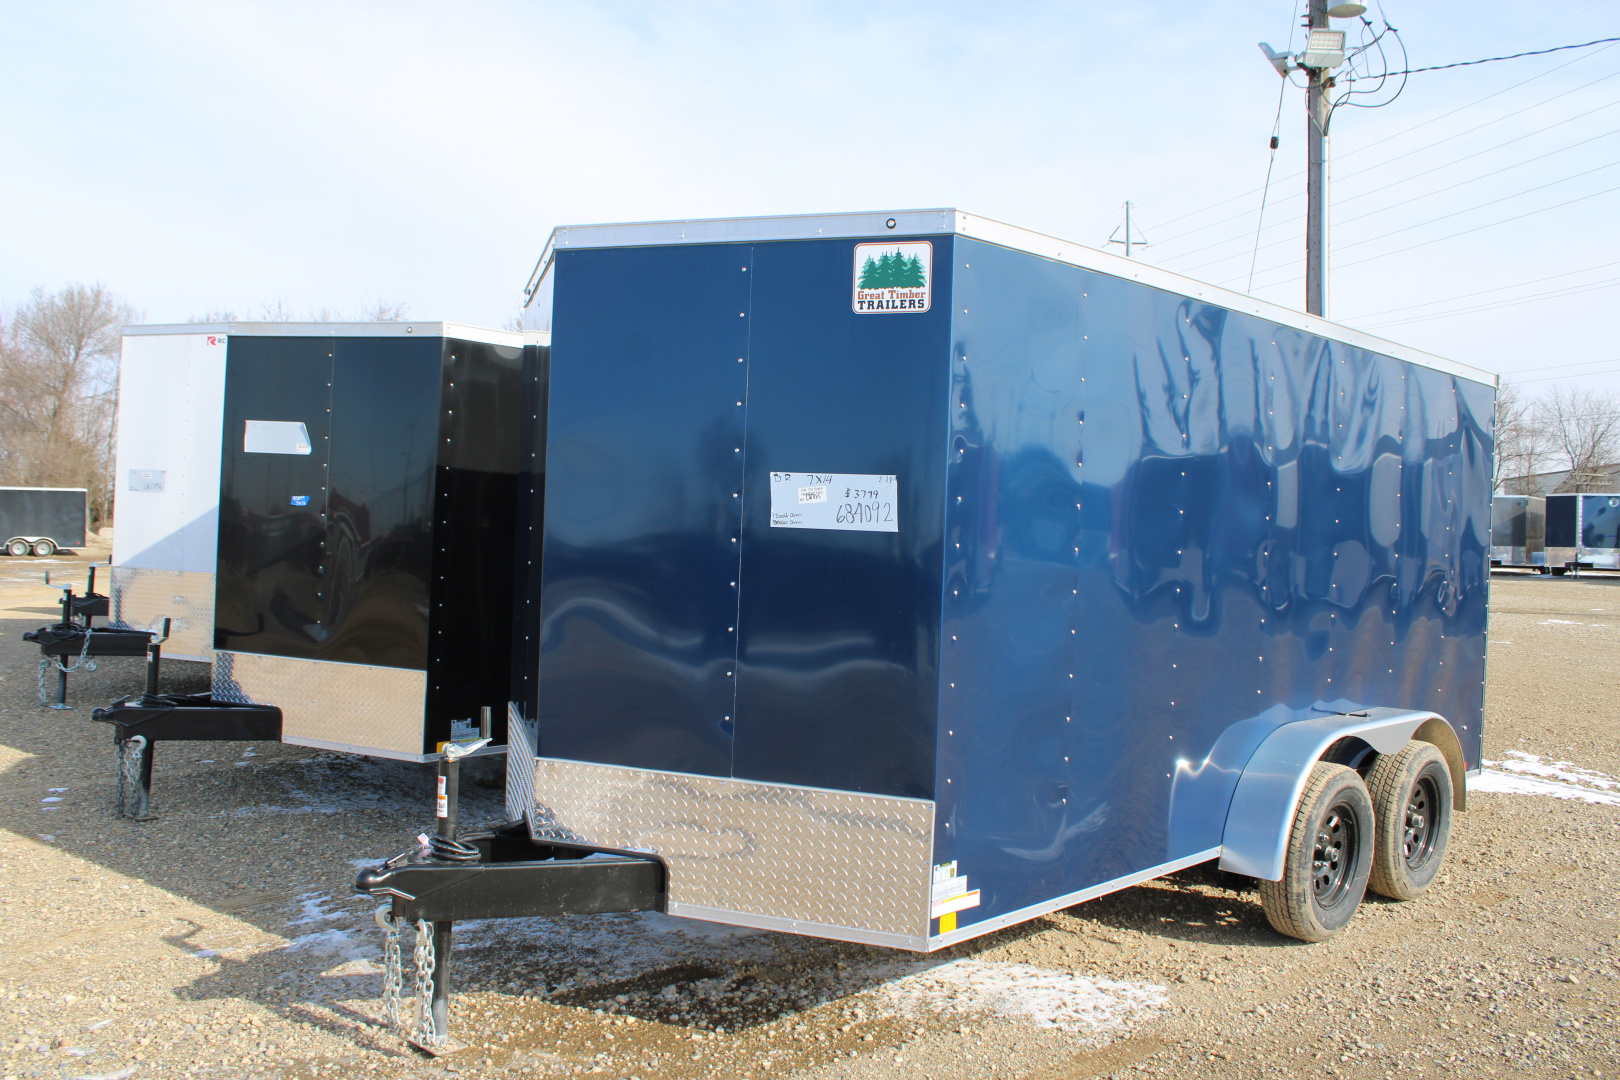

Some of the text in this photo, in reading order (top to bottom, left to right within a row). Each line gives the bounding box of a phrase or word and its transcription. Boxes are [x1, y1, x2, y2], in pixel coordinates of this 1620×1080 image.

[858, 289, 926, 300] Great Timber
[858, 299, 925, 310] TRAILERS
[836, 500, 894, 524] 684092
